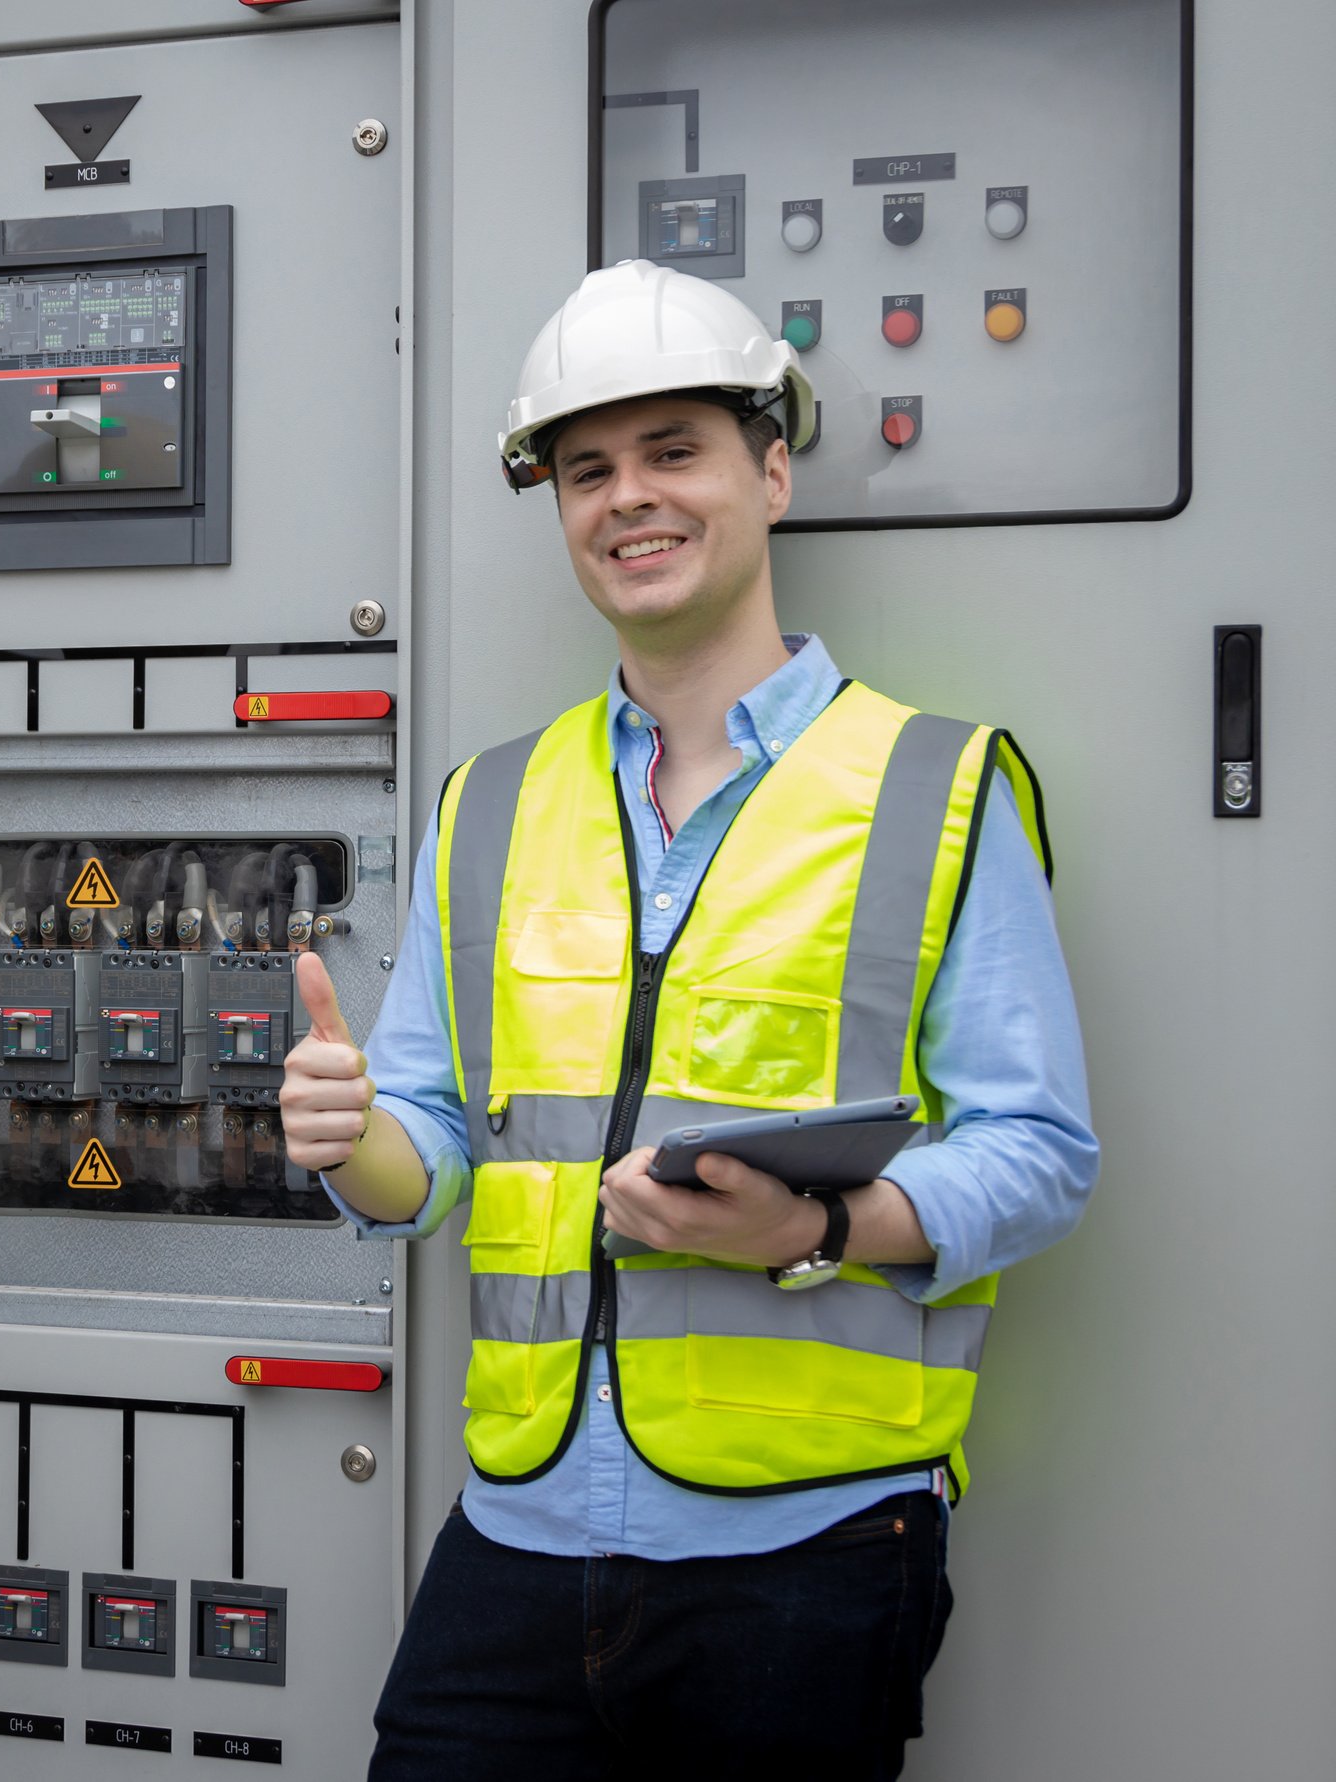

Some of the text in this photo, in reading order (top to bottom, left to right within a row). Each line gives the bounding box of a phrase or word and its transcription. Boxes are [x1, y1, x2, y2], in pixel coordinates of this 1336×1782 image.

[77, 167, 98, 181] MCB
[887, 161, 921, 177] CHP-1
[990, 189, 1024, 199] REMOTE
[789, 202, 815, 212] LOCAL
[991, 290, 1019, 301] FAULT
[895, 297, 910, 307] OFF
[793, 303, 811, 312] RUN
[890, 398, 913, 408] STOP
[105, 470, 117, 479] off
[10, 1718, 34, 1733] CH-6
[116, 1729, 140, 1744] CH-7
[224, 1740, 250, 1755] CH-8
